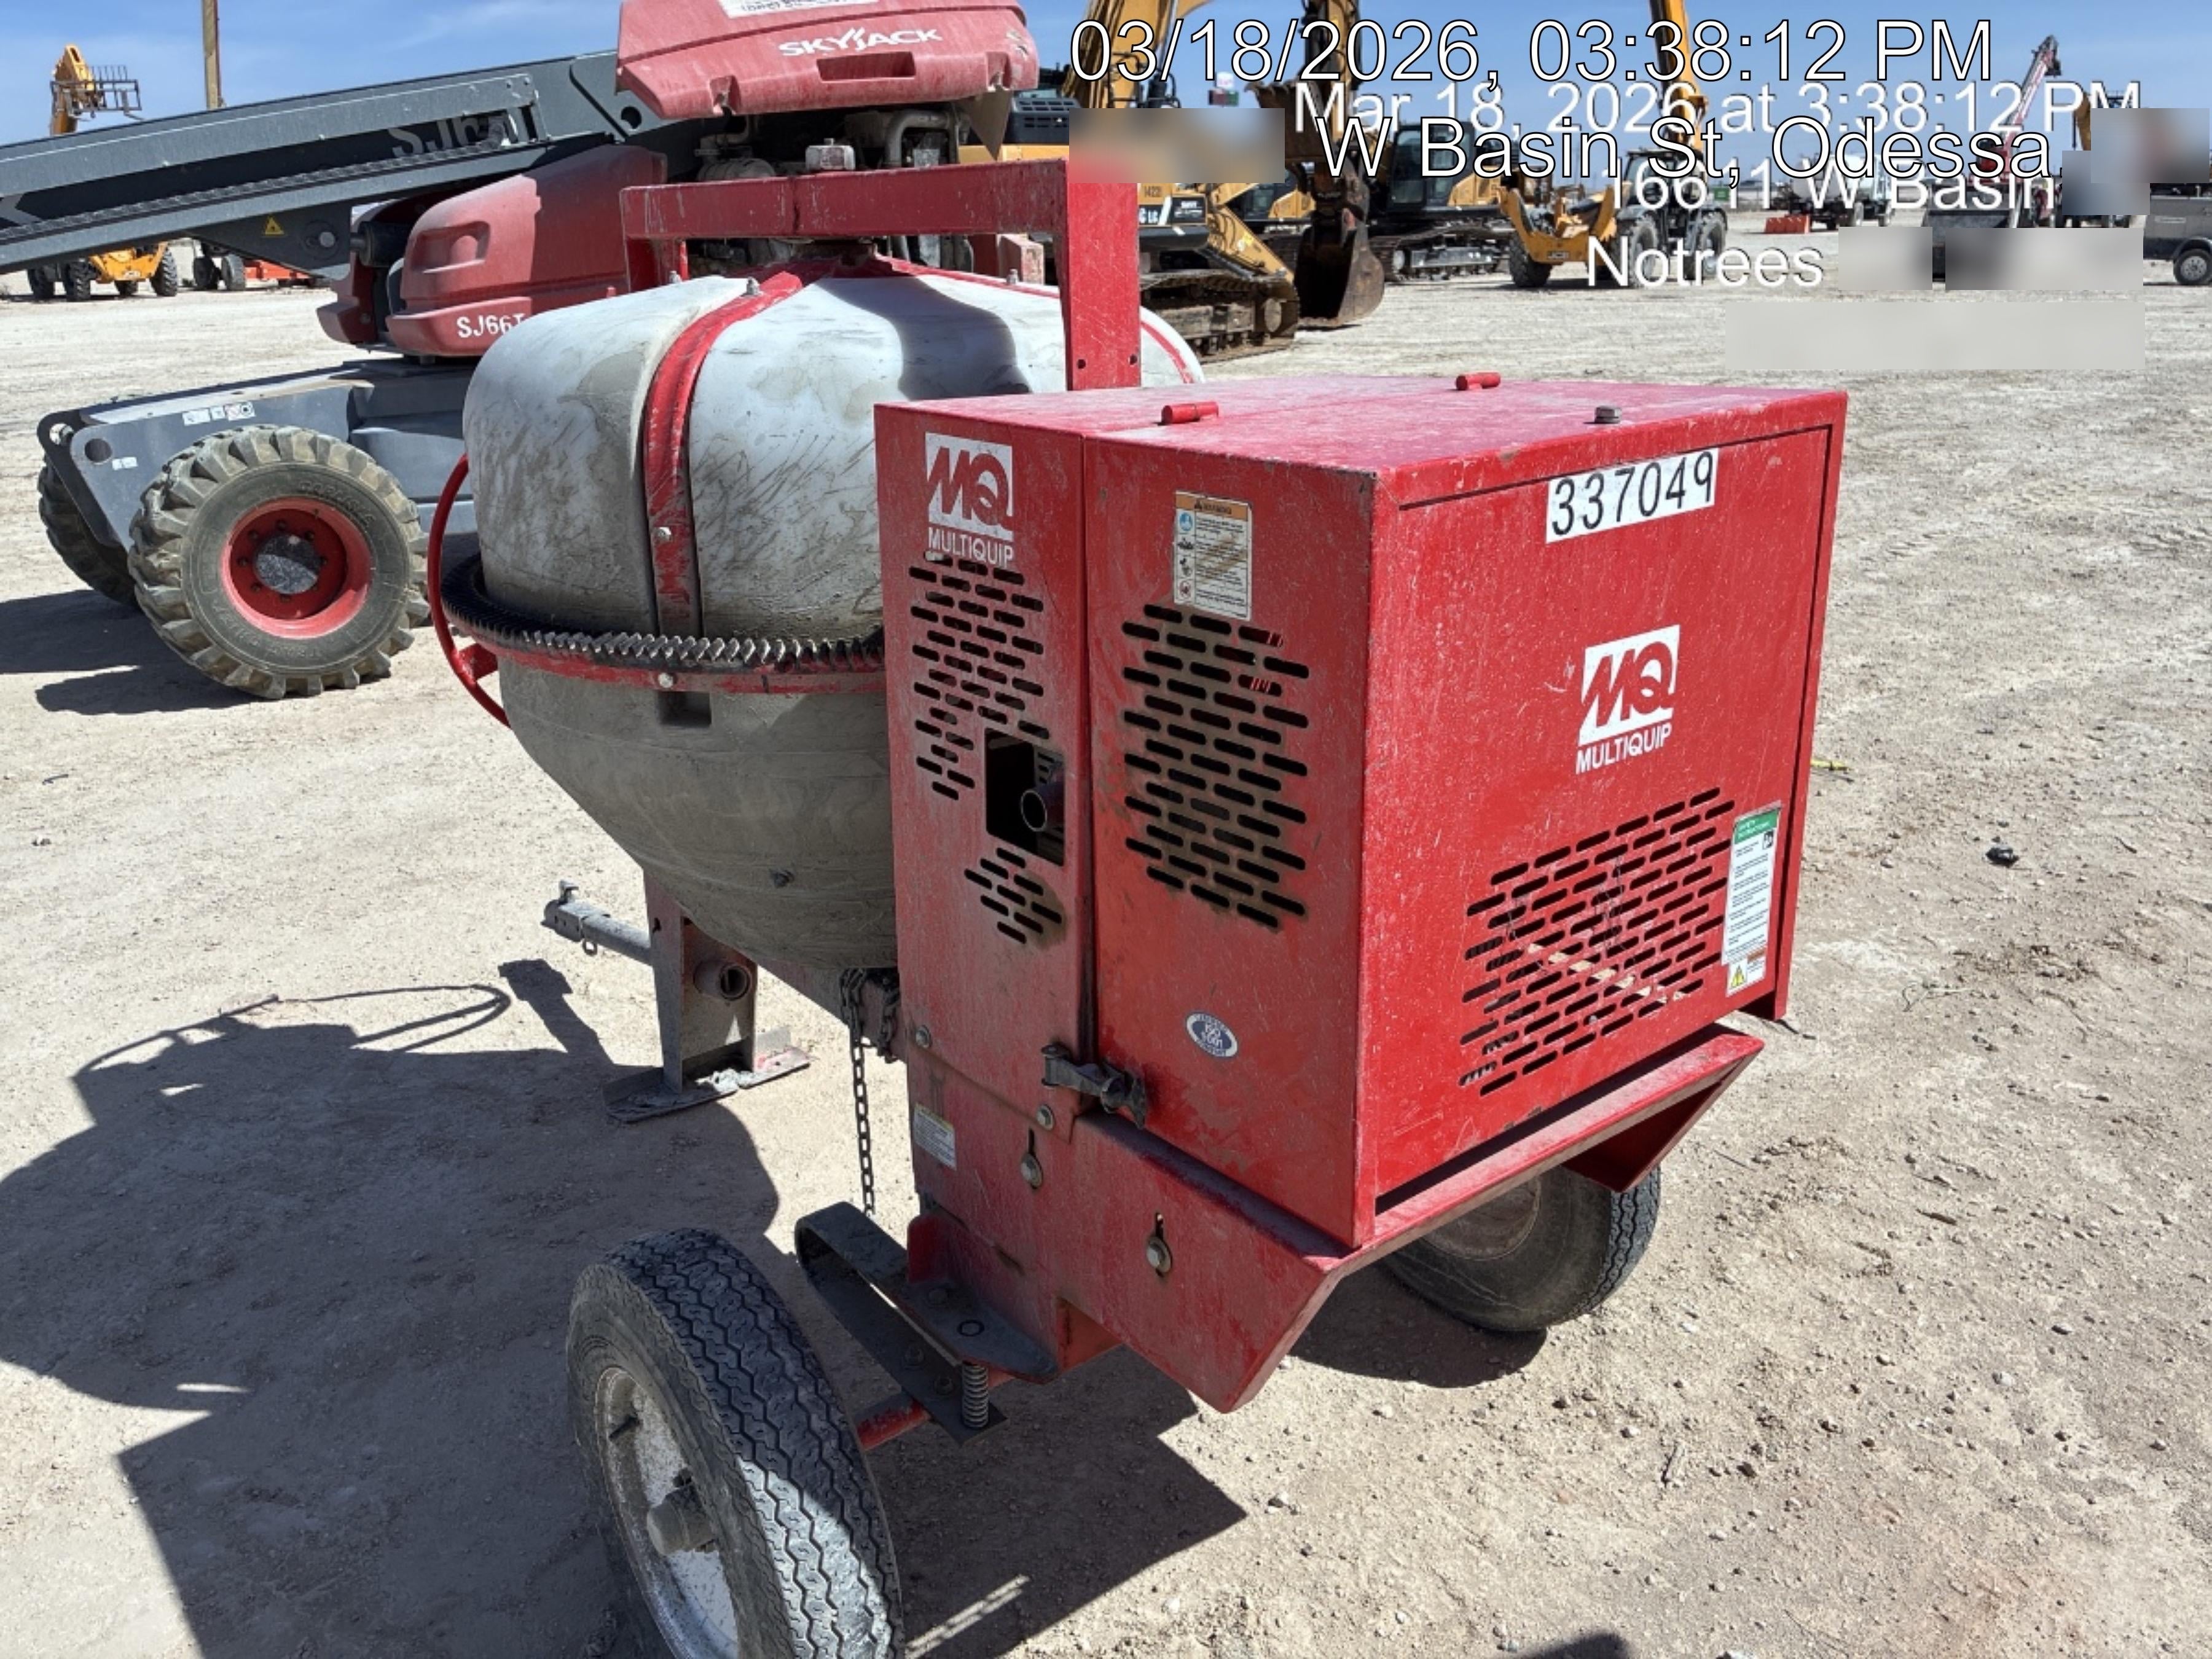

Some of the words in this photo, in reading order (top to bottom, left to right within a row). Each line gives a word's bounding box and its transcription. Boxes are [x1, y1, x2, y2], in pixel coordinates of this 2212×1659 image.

[778, 28, 943, 56] SKYJACK
[926, 445, 1013, 530] MQ
[1551, 451, 1715, 536] 337049
[928, 527, 1014, 567] MULTIQUIP
[1579, 639, 1676, 731] MQ
[1575, 723, 1673, 774] MULTIQUIP
